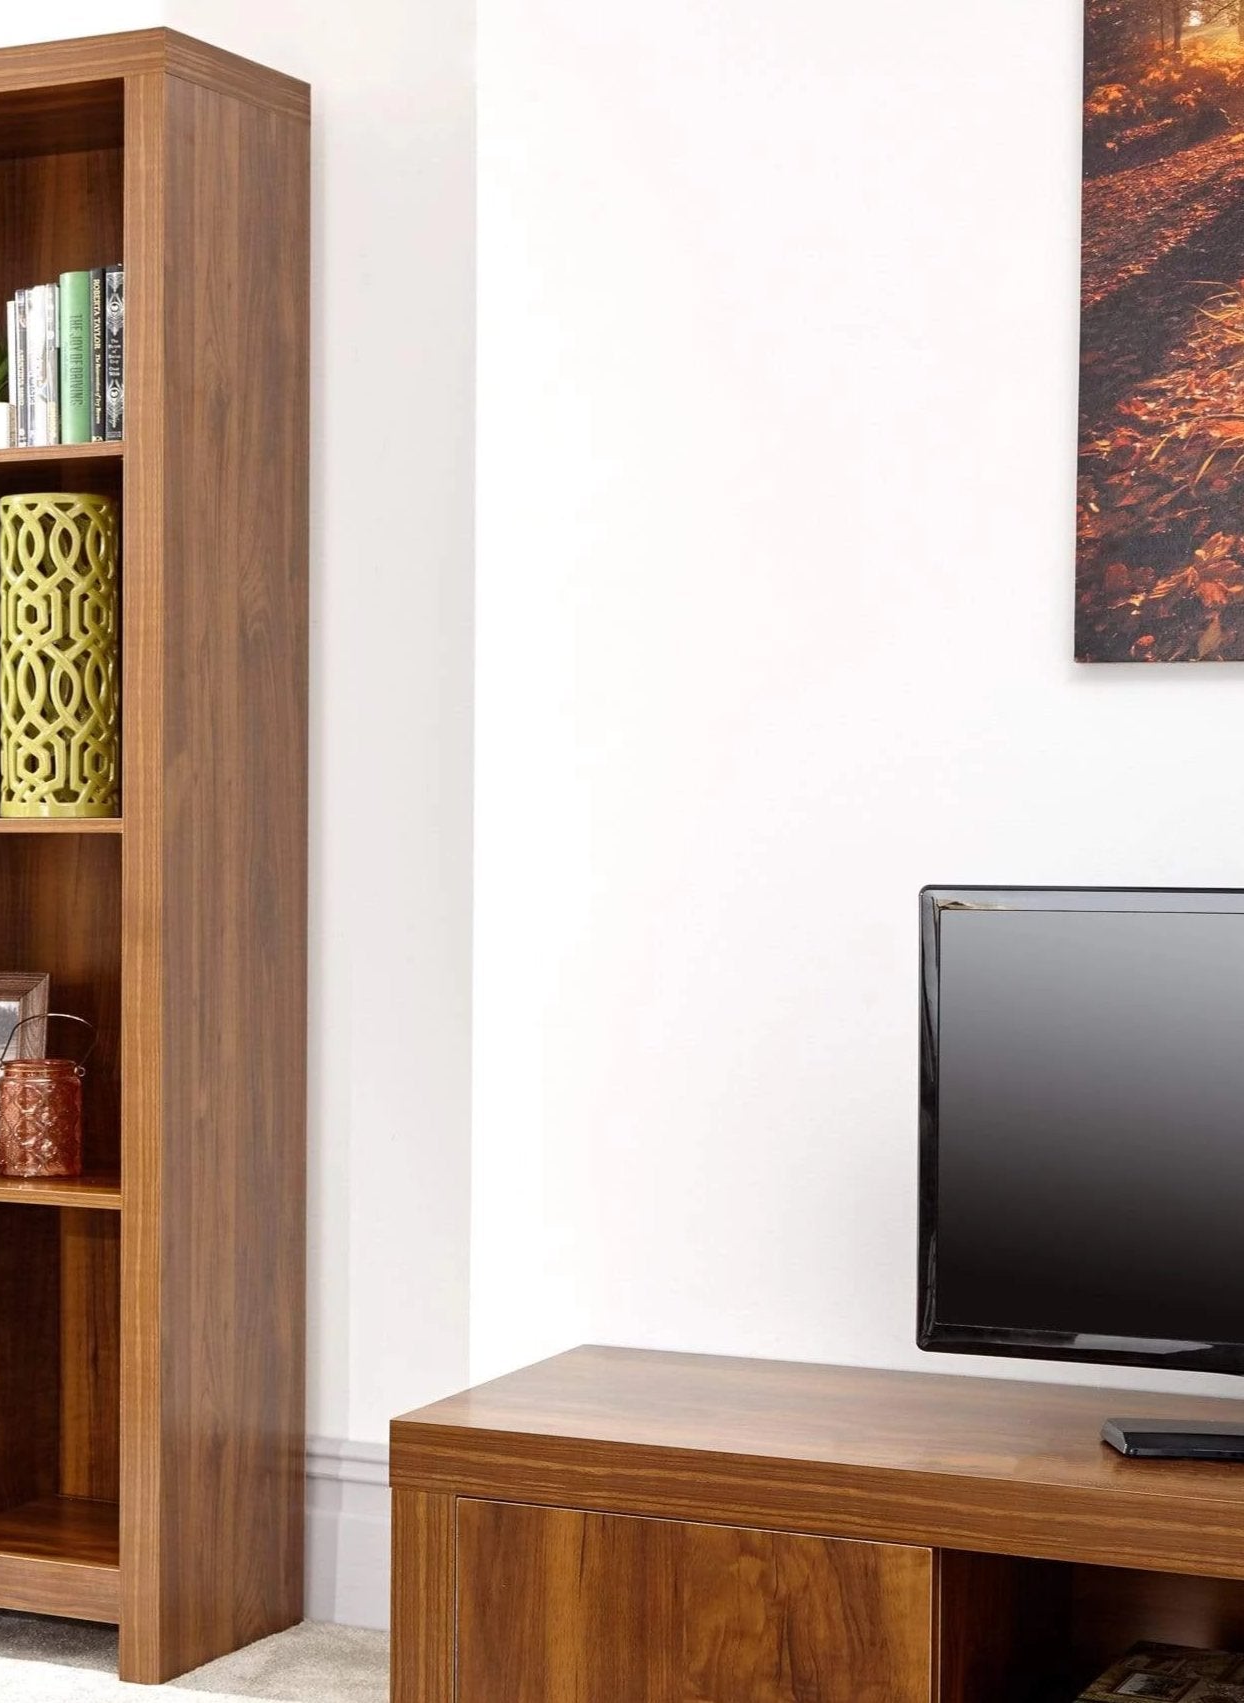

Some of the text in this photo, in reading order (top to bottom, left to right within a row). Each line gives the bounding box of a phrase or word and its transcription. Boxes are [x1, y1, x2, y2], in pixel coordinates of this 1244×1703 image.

[93, 279, 101, 316] ROBERTA
[69, 315, 83, 331] THE
[69, 332, 83, 351] JOY
[69, 353, 83, 365] OF
